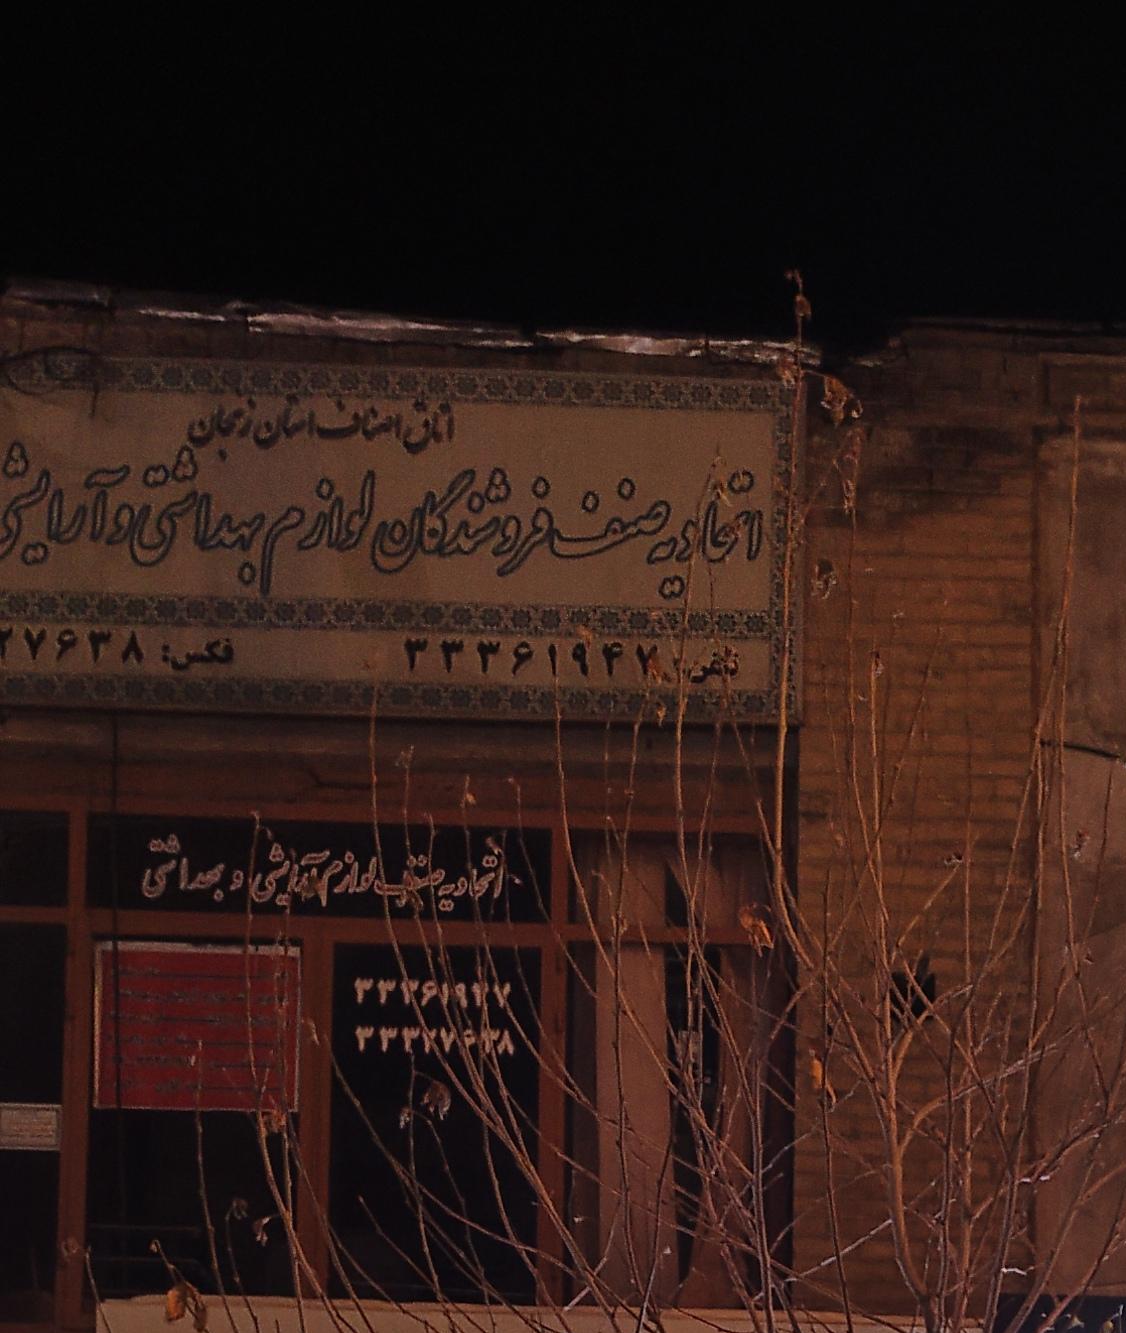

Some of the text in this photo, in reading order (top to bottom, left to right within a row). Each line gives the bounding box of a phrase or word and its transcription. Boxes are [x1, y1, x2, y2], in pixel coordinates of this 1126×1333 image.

[188, 395, 455, 461] اتاق اصناف استان زنجان
[106, 503, 136, 546] و
[130, 445, 265, 586] بهداشتی
[260, 469, 375, 596] لوازم
[371, 467, 554, 577] فروشندگان
[550, 477, 672, 559] صنف
[646, 469, 763, 600] اتحادیه
[404, 637, 658, 677] ۳۳۳۶۱۹۴۷
[140, 832, 226, 903] بهداشتی
[228, 868, 246, 892] و
